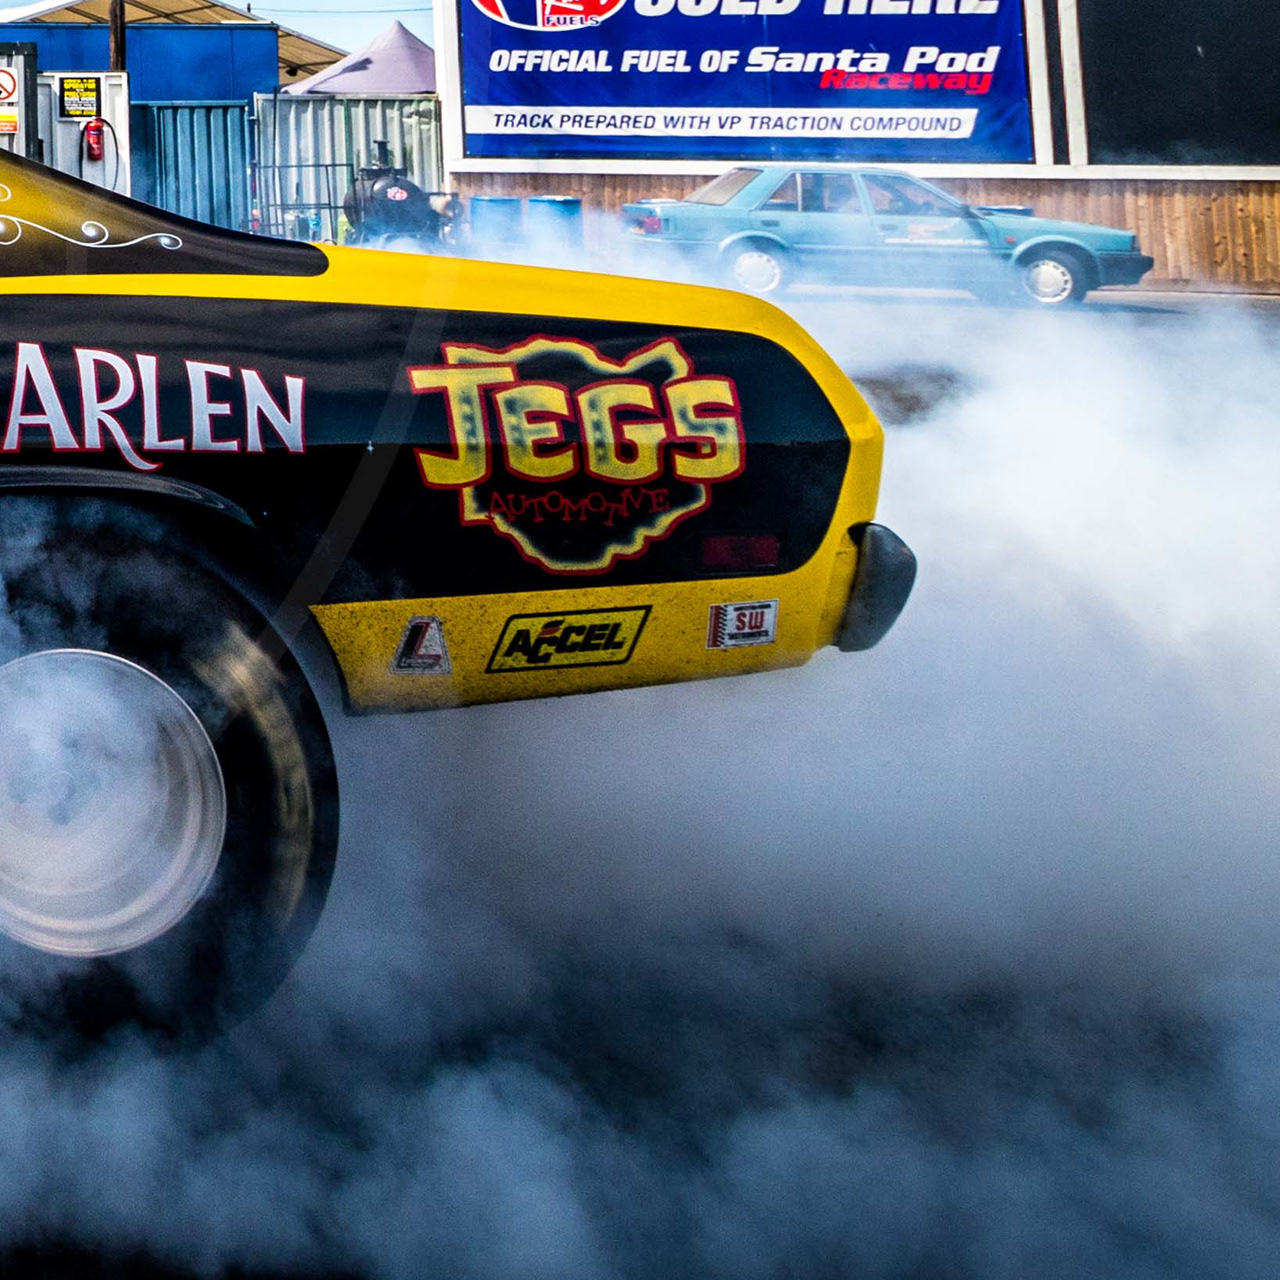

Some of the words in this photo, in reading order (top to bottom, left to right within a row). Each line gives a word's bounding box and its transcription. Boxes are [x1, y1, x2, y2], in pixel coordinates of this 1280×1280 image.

[544, 14, 601, 27] FUELS
[489, 49, 612, 72] OFFICIAL
[620, 50, 692, 72] FUEL
[699, 50, 740, 72] OF
[744, 46, 890, 72] Santa
[903, 46, 1001, 73] Pod
[819, 69, 994, 95] Raceway
[493, 113, 555, 128] TRACK
[559, 115, 657, 129] PREPARED
[662, 115, 711, 130] WITH
[717, 116, 741, 130] VP
[749, 116, 846, 131] TRACTION
[849, 116, 962, 132] COMPOUND
[1, 341, 307, 472] ARLEN
[406, 362, 746, 489] JEGS
[735, 611, 765, 631] SW
[503, 620, 626, 664] ACCEL
